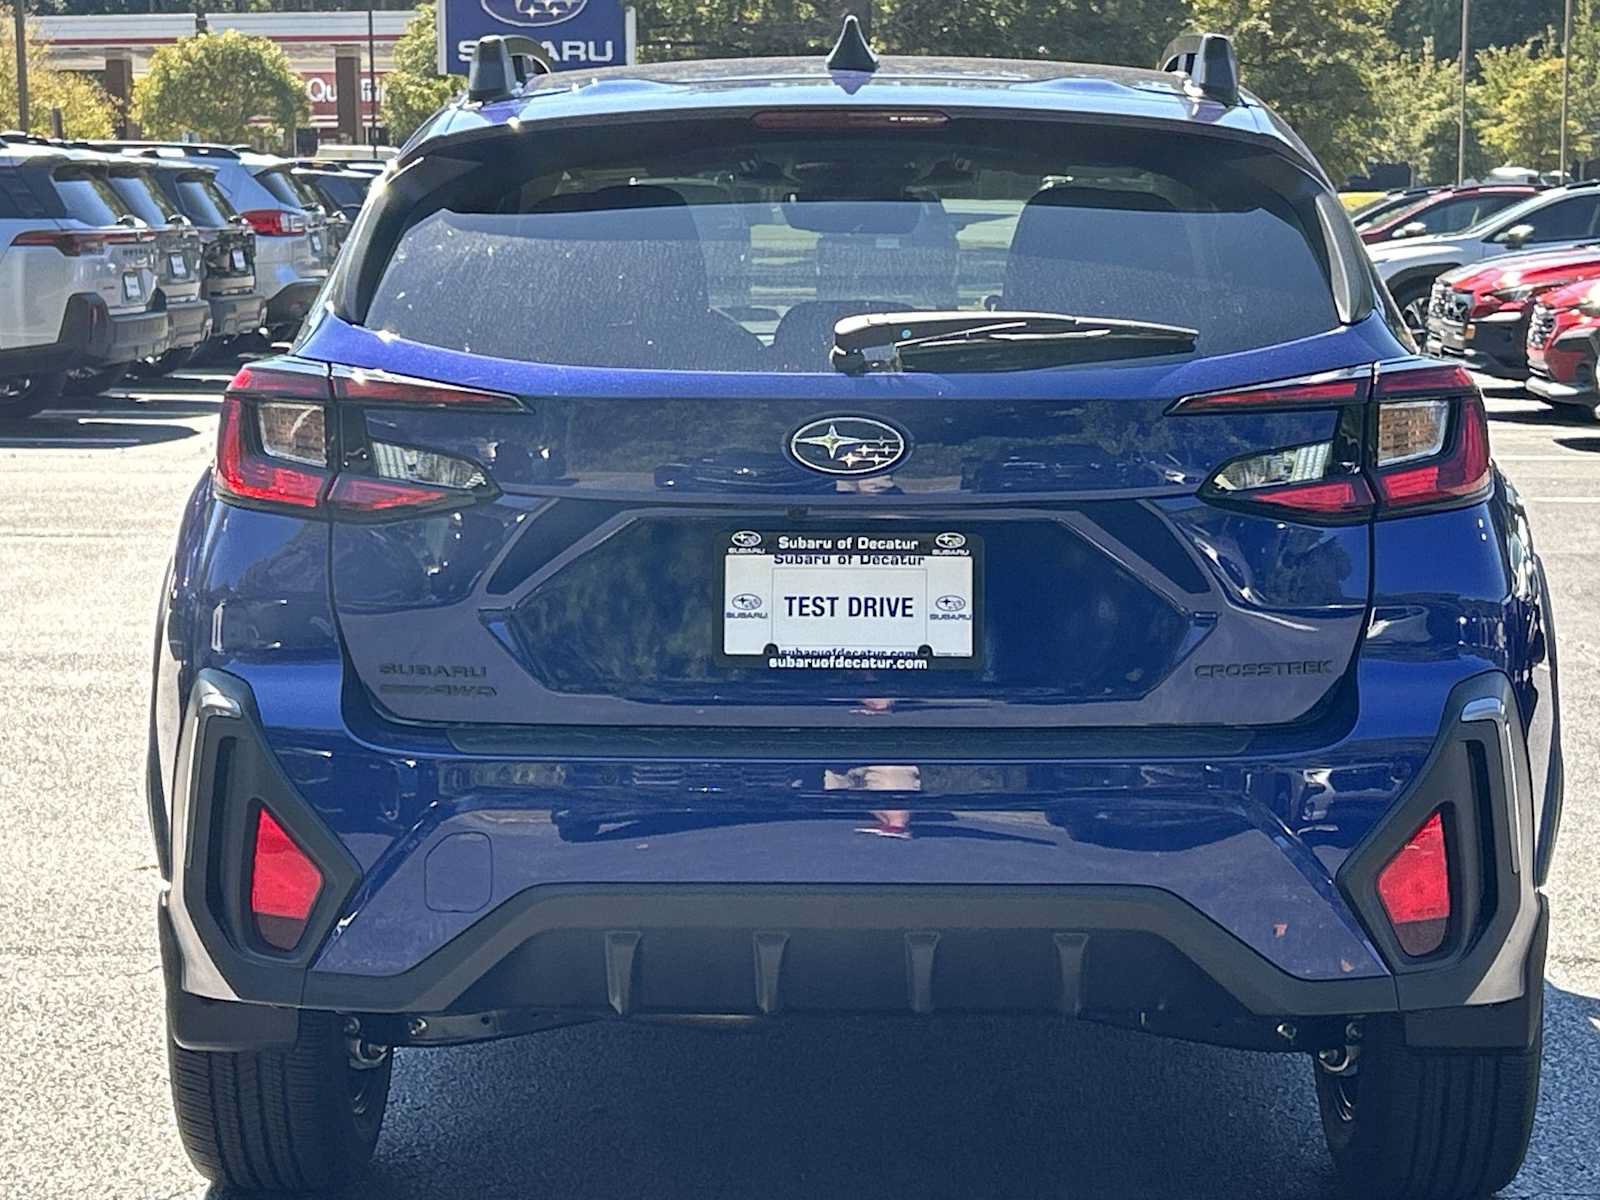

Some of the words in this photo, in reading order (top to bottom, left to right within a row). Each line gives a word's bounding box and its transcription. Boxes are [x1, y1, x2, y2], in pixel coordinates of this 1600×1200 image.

[778, 536, 832, 549] Subaru
[837, 536, 852, 549] of
[858, 537, 919, 550] Decatur
[774, 554, 830, 565] Subaru
[784, 596, 839, 617] TEST
[848, 597, 914, 618] DRIVE
[768, 657, 928, 668] subaruofdecatur.com
[1195, 660, 1333, 678] CROSSTREK
[380, 664, 487, 677] SUBARU
